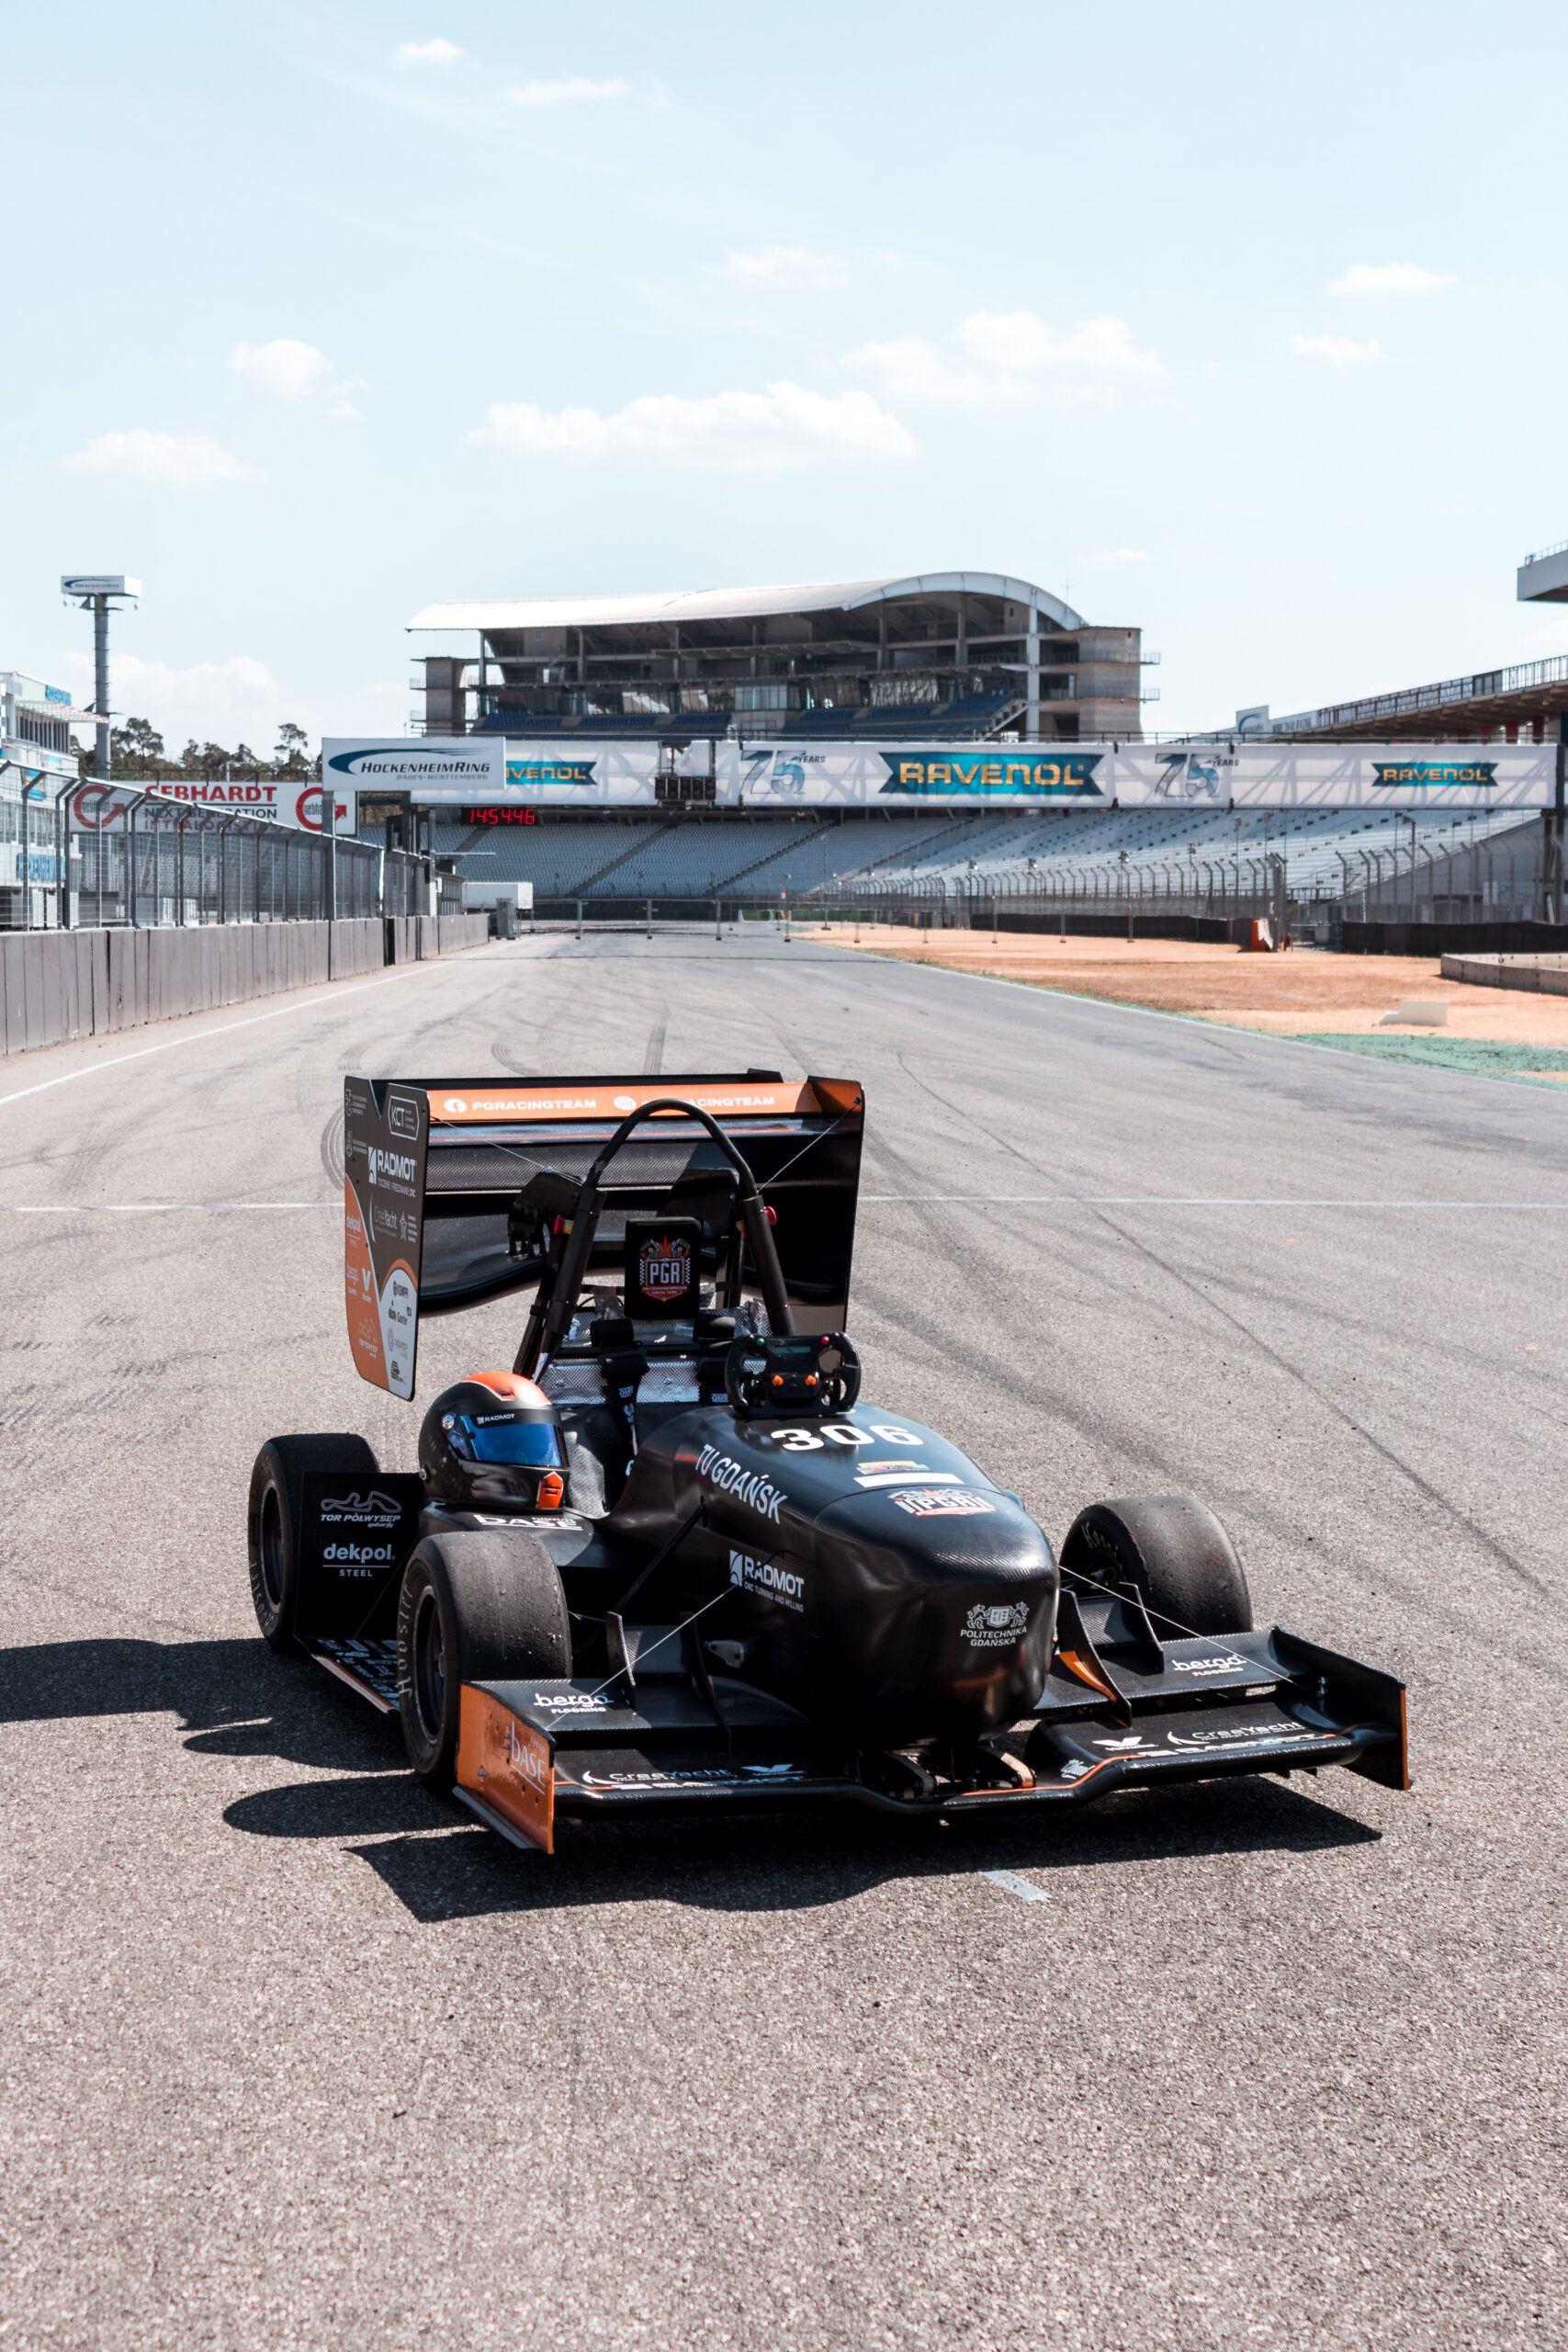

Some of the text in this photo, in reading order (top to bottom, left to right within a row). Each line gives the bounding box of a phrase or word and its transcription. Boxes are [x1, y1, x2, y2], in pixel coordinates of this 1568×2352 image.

[506, 767, 586, 780] VENOL
[899, 763, 1084, 786] RAVENOL
[1155, 753, 1221, 797] 75
[1383, 768, 1488, 781] RAVENOL
[304, 804, 322, 816] gebha
[472, 1099, 597, 1111] PGRACINGTEAM
[391, 1104, 405, 1127] KCT
[377, 1148, 416, 1182] RADMOT
[649, 1262, 681, 1284] PGR
[484, 1413, 515, 1422] RADMOT
[770, 1424, 924, 1452] 306
[695, 1443, 789, 1525] TU GDAŃSK
[321, 1514, 343, 1522] TOR
[323, 1544, 392, 1564] dekpol
[339, 1569, 373, 1577] STEEL
[744, 1555, 805, 1598] RADMOT
[754, 1585, 773, 1600] TURNING
[774, 1594, 785, 1604] AND
[960, 1625, 1027, 1639] POLITECHNIKA
[970, 1636, 1016, 1647] GDAŃSKA
[1191, 1667, 1244, 1677] FLOORING
[550, 1706, 607, 1714] FLOORING
